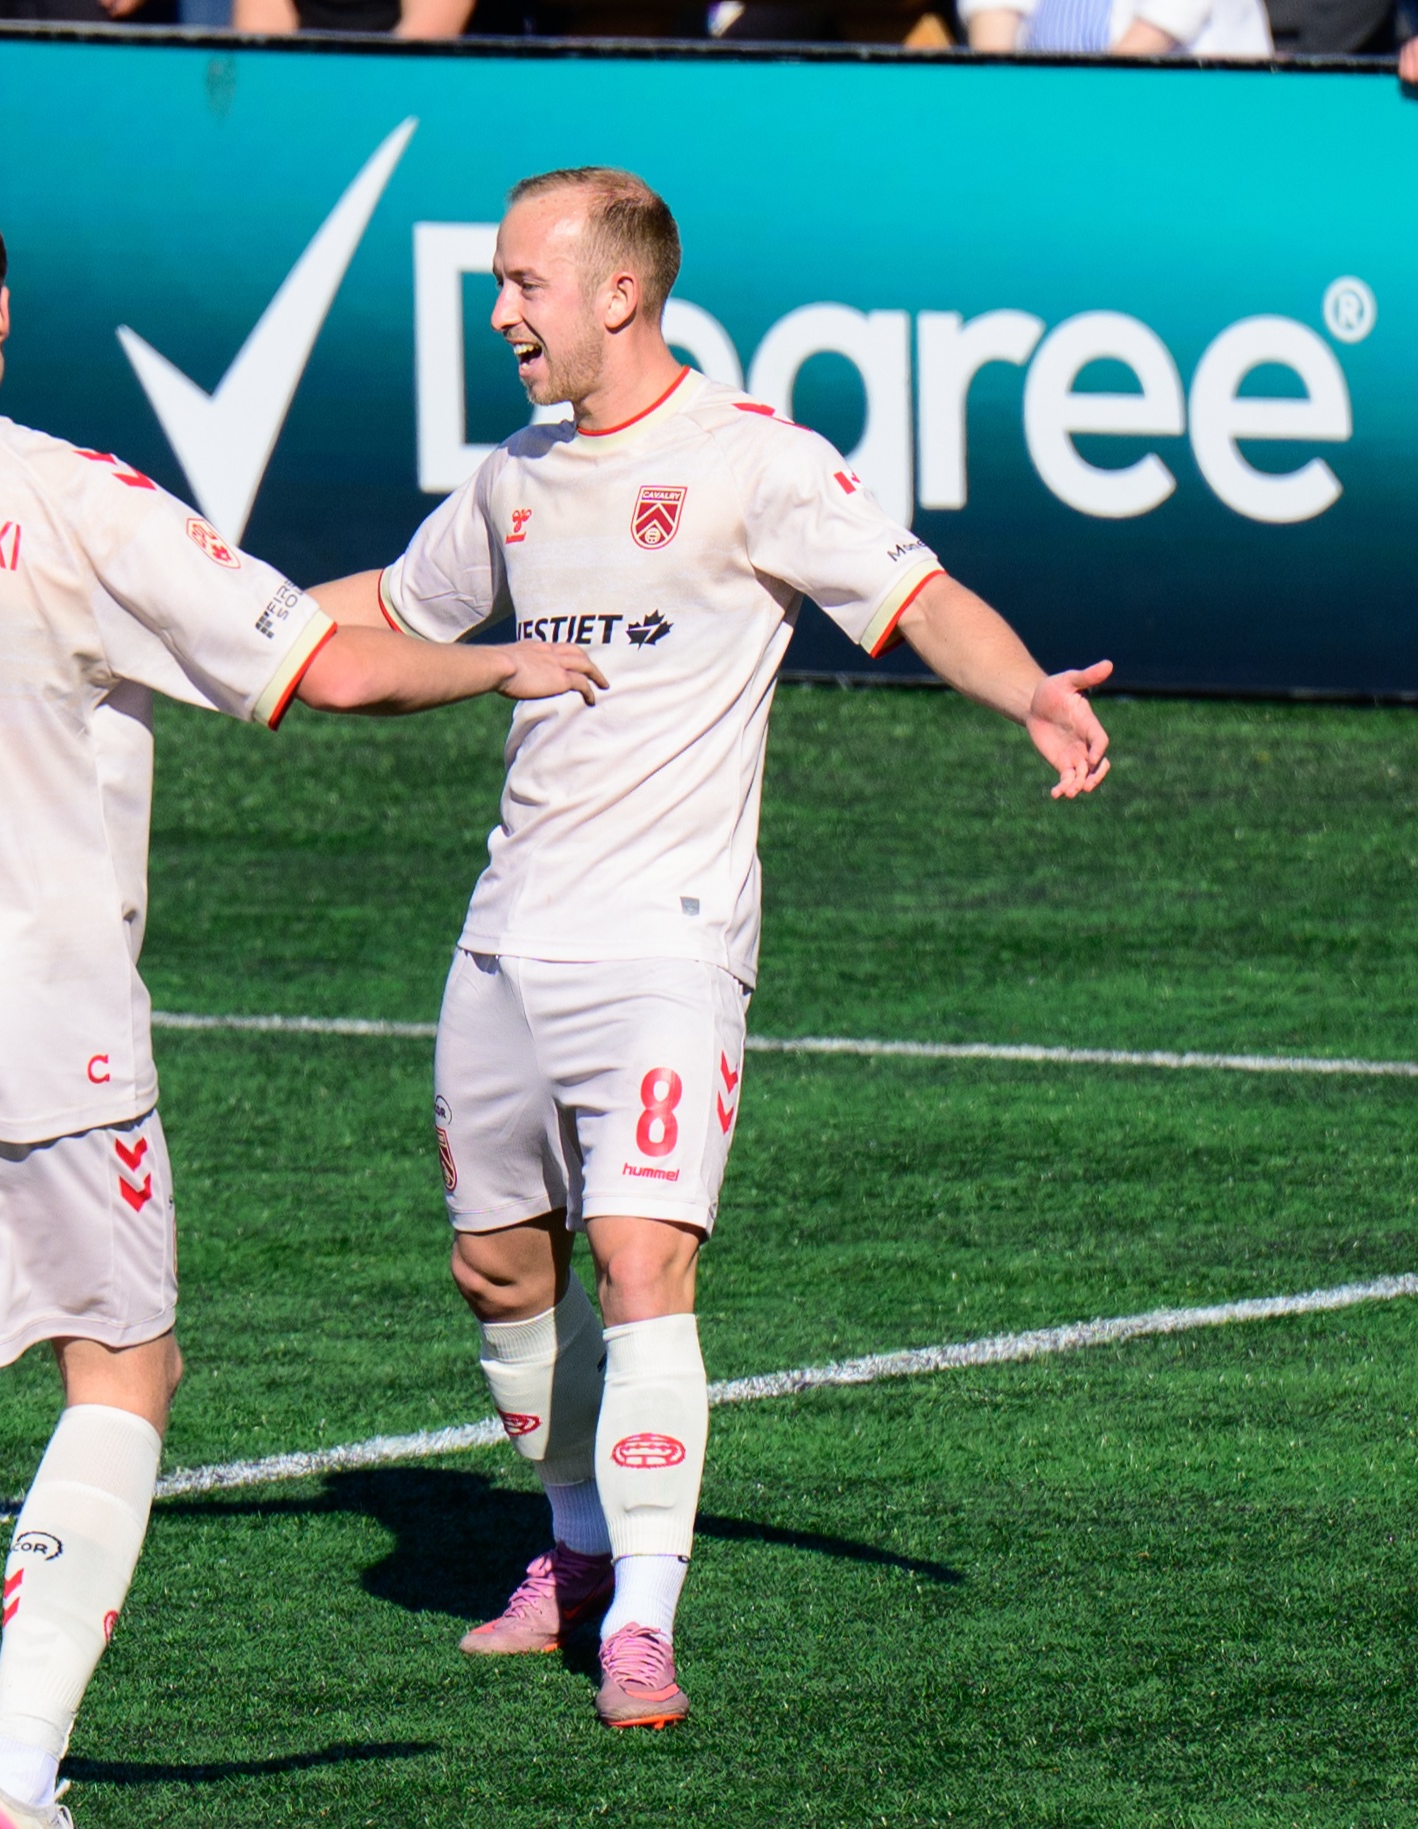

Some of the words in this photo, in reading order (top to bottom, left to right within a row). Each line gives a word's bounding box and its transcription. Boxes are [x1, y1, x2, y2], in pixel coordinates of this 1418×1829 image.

[642, 490, 682, 501] CAVALRY
[517, 614, 624, 645] ESTJET
[87, 1055, 111, 1084] C
[635, 1066, 683, 1157] 8
[622, 1162, 680, 1182] hummel
